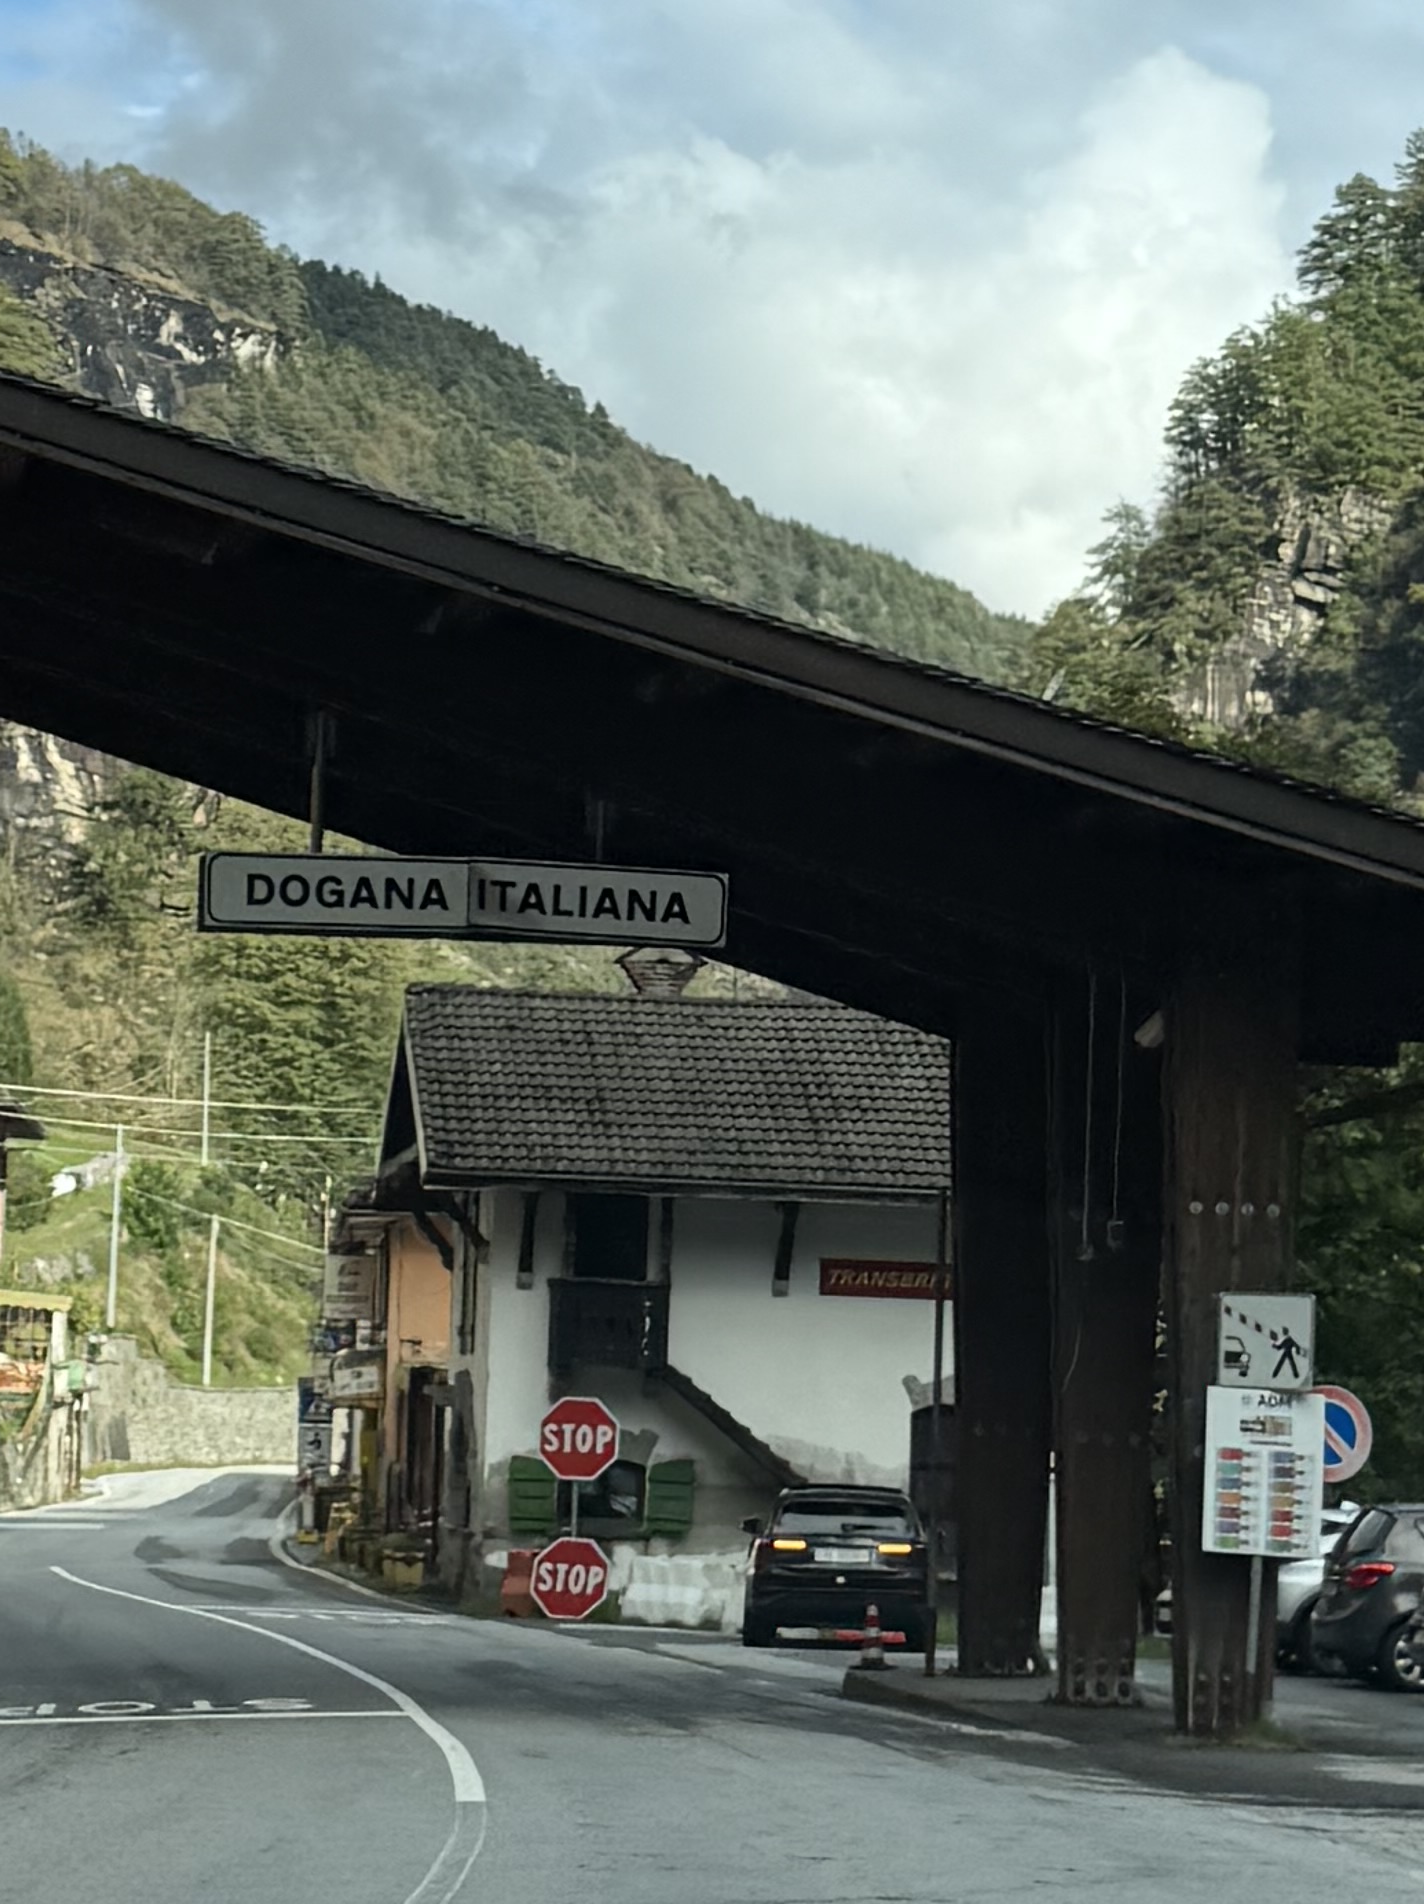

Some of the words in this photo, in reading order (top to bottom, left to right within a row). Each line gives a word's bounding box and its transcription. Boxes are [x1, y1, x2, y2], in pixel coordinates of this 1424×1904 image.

[246, 872, 450, 912] DOGANA
[477, 878, 692, 925] ITALIANA
[543, 1422, 614, 1455] STOP
[537, 1561, 605, 1596] STOP
